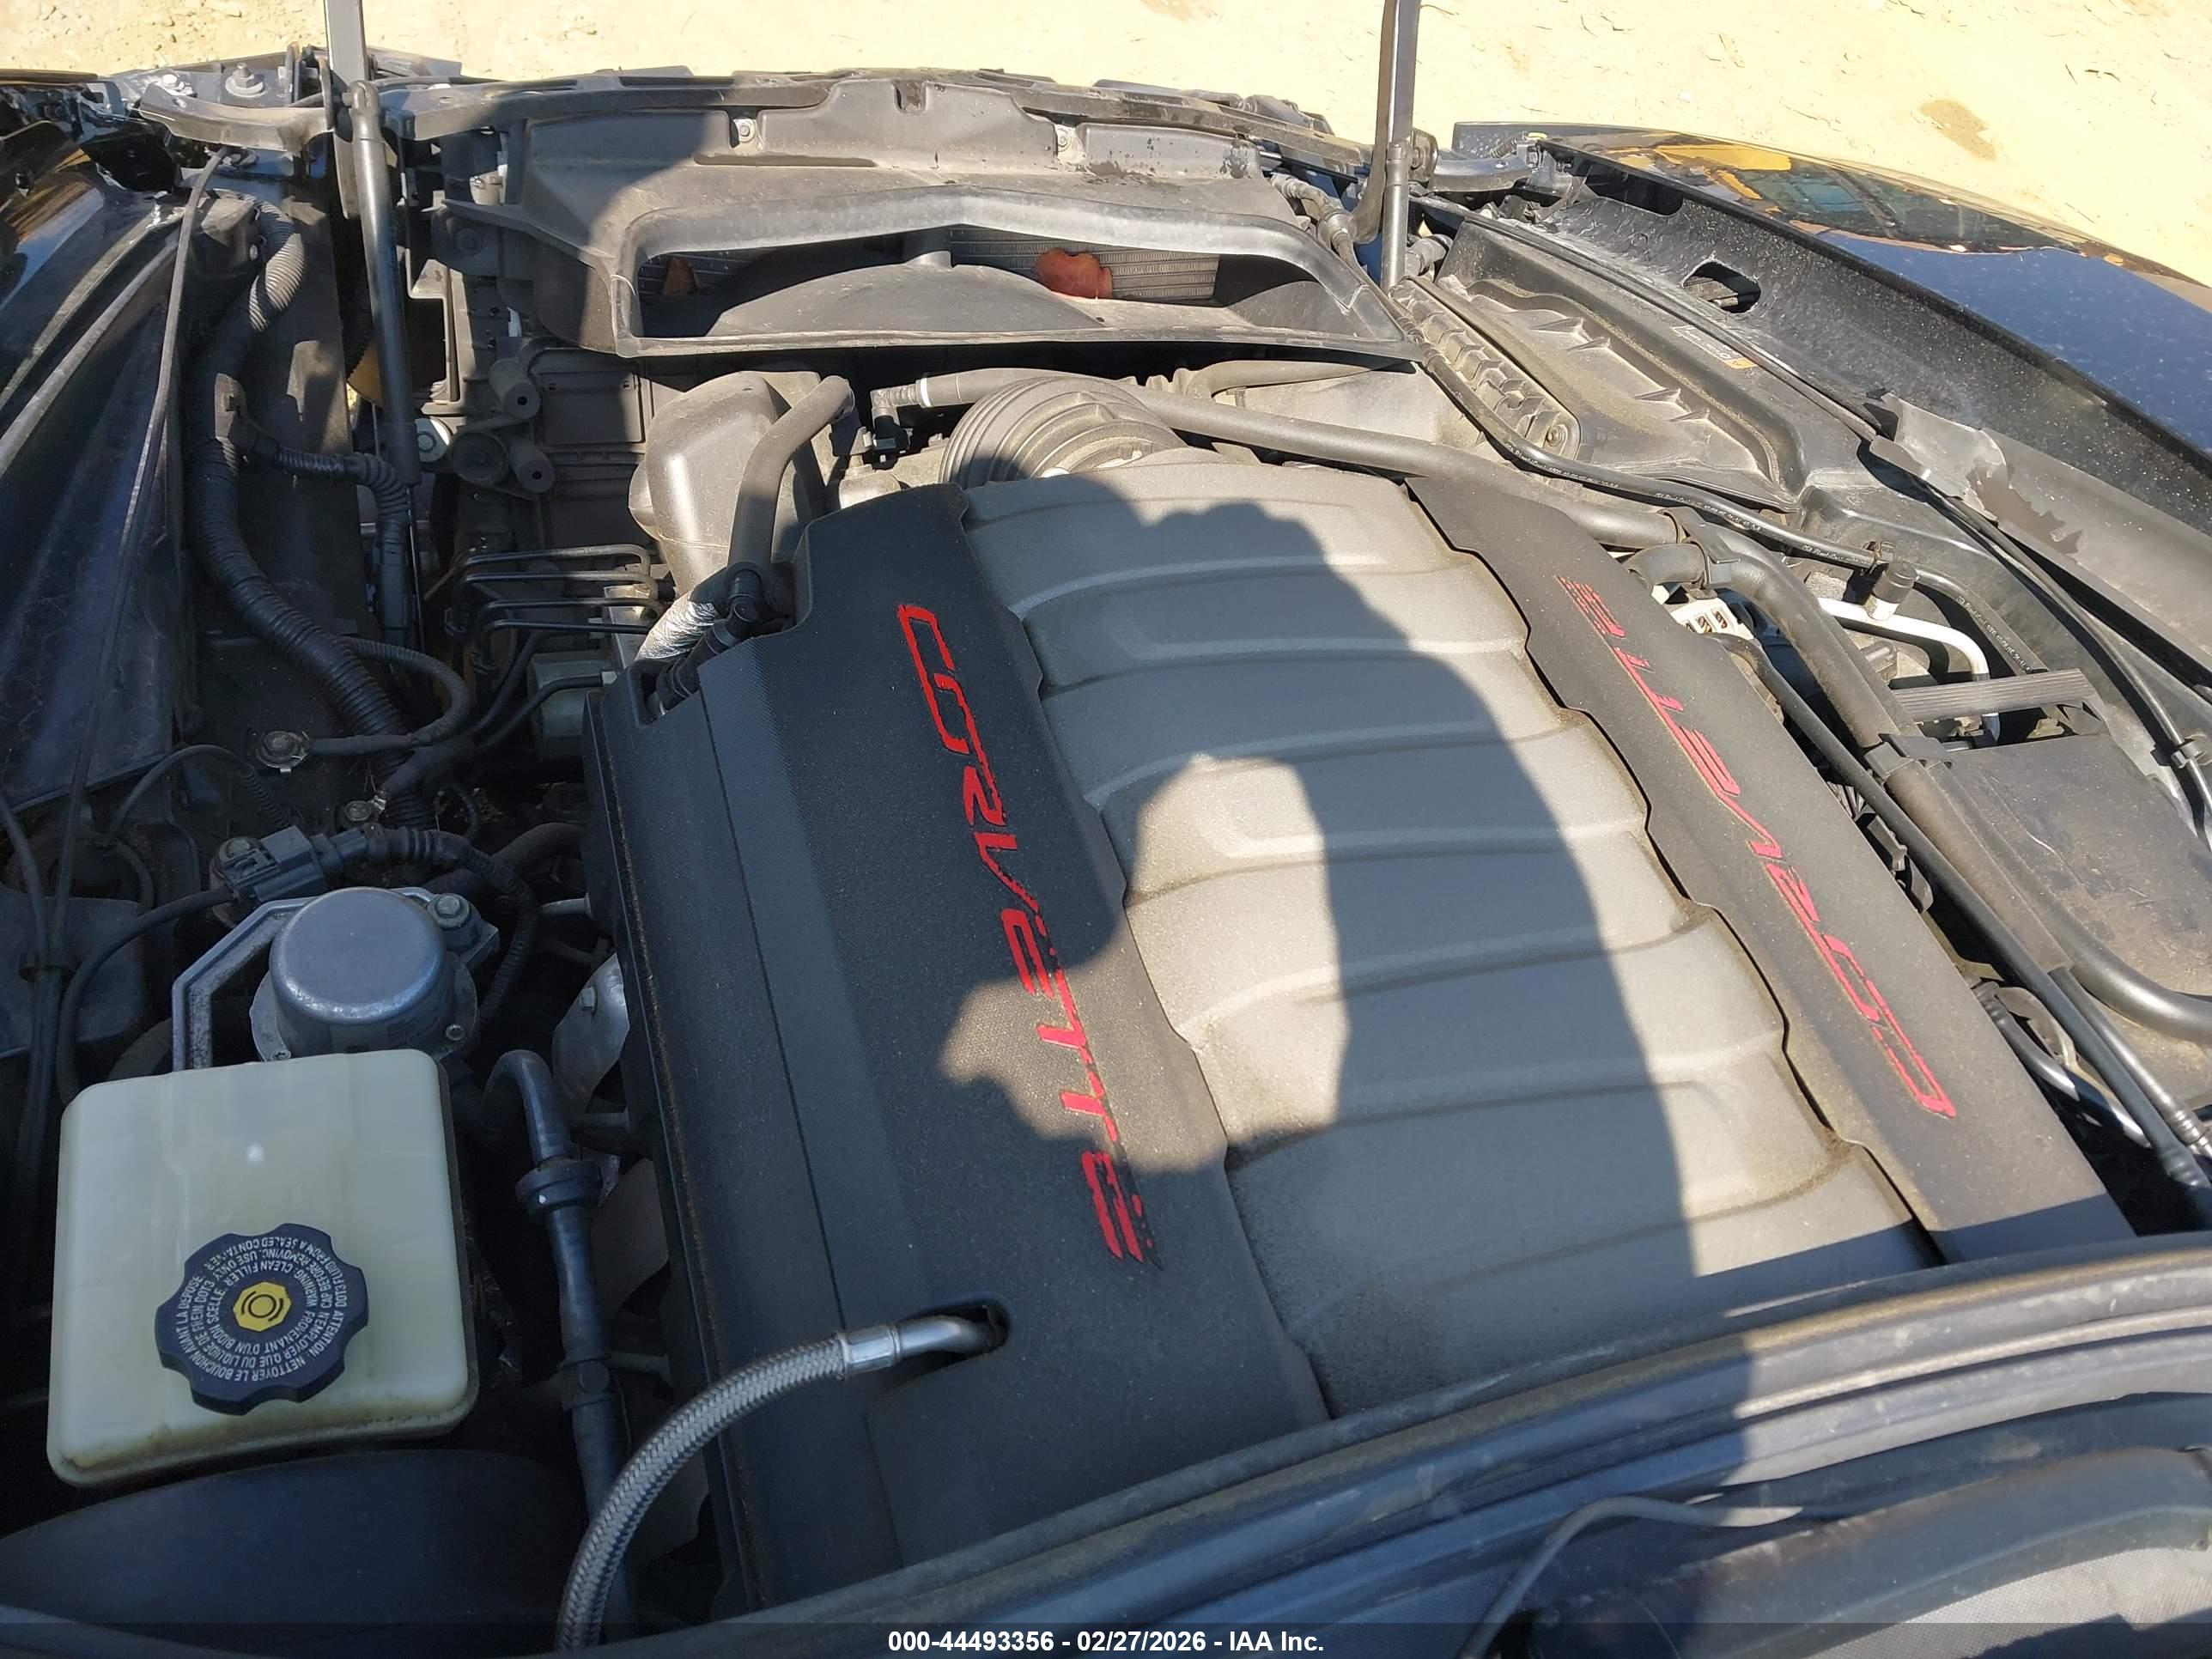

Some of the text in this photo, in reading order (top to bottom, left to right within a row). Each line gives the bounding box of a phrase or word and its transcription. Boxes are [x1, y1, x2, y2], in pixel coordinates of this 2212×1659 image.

[1554, 576, 1956, 1118] CORVETTE
[897, 605, 1164, 1271] CORVETTE
[299, 1240, 307, 1249] A
[304, 1243, 331, 1266] FROM
[236, 1250, 258, 1266] USE
[260, 1260, 294, 1273] CLEAN
[212, 1260, 237, 1281] ONLY
[222, 1261, 258, 1286] FILLER
[309, 1260, 331, 1292] BEFORE
[325, 1261, 344, 1285] FLUID
[194, 1279, 216, 1303] DOT3
[319, 1292, 333, 1309] CAP
[335, 1284, 347, 1308] DOT3
[175, 1310, 189, 1325] LA
[191, 1304, 205, 1333] FREIN
[175, 1326, 198, 1354] AVANT
[194, 1331, 211, 1346] DE
[209, 1323, 236, 1350] BIDON
[264, 1310, 315, 1354] PROVENANT
[189, 1350, 234, 1380] BOUCHON
[203, 1341, 240, 1367] LIQUIDE
[240, 1356, 256, 1369] DU
[259, 1352, 282, 1368] QUE
[234, 1370, 249, 1382] LE
[252, 1356, 306, 1382] NETTOYER
